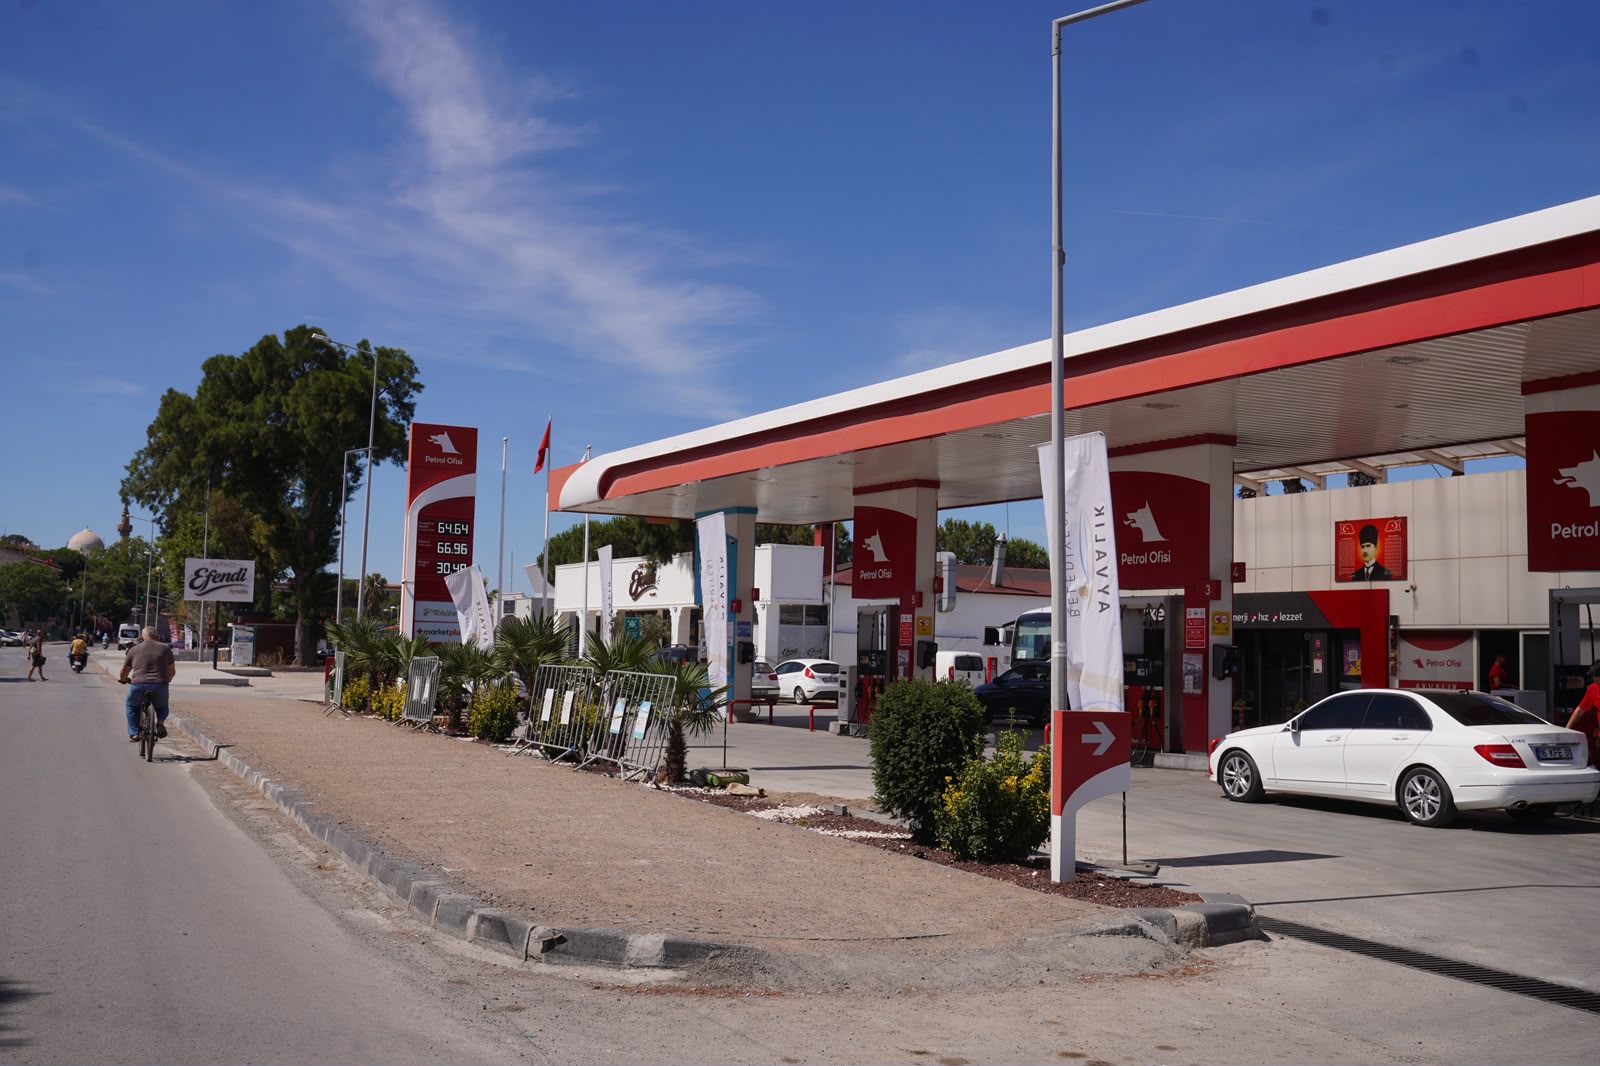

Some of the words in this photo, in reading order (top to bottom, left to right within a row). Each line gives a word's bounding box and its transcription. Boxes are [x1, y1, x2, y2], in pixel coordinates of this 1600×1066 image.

[425, 455, 445, 464] Petrol
[446, 457, 463, 465] Ofisi
[437, 522, 469, 535] 64.64
[1551, 520, 1599, 539] Petrol
[437, 542, 468, 555] 66.96
[1121, 552, 1148, 566] Petrol
[1149, 549, 1171, 564] Ofisi
[860, 570, 877, 580] Petrol
[877, 568, 893, 579] Ofisi
[1232, 566, 1239, 577] 4
[188, 567, 248, 592] Efendi
[1205, 584, 1211, 596] 3
[1279, 612, 1303, 621] lezzet
[1426, 658, 1445, 667] Petrol
[1445, 659, 1462, 667] Ofisi
